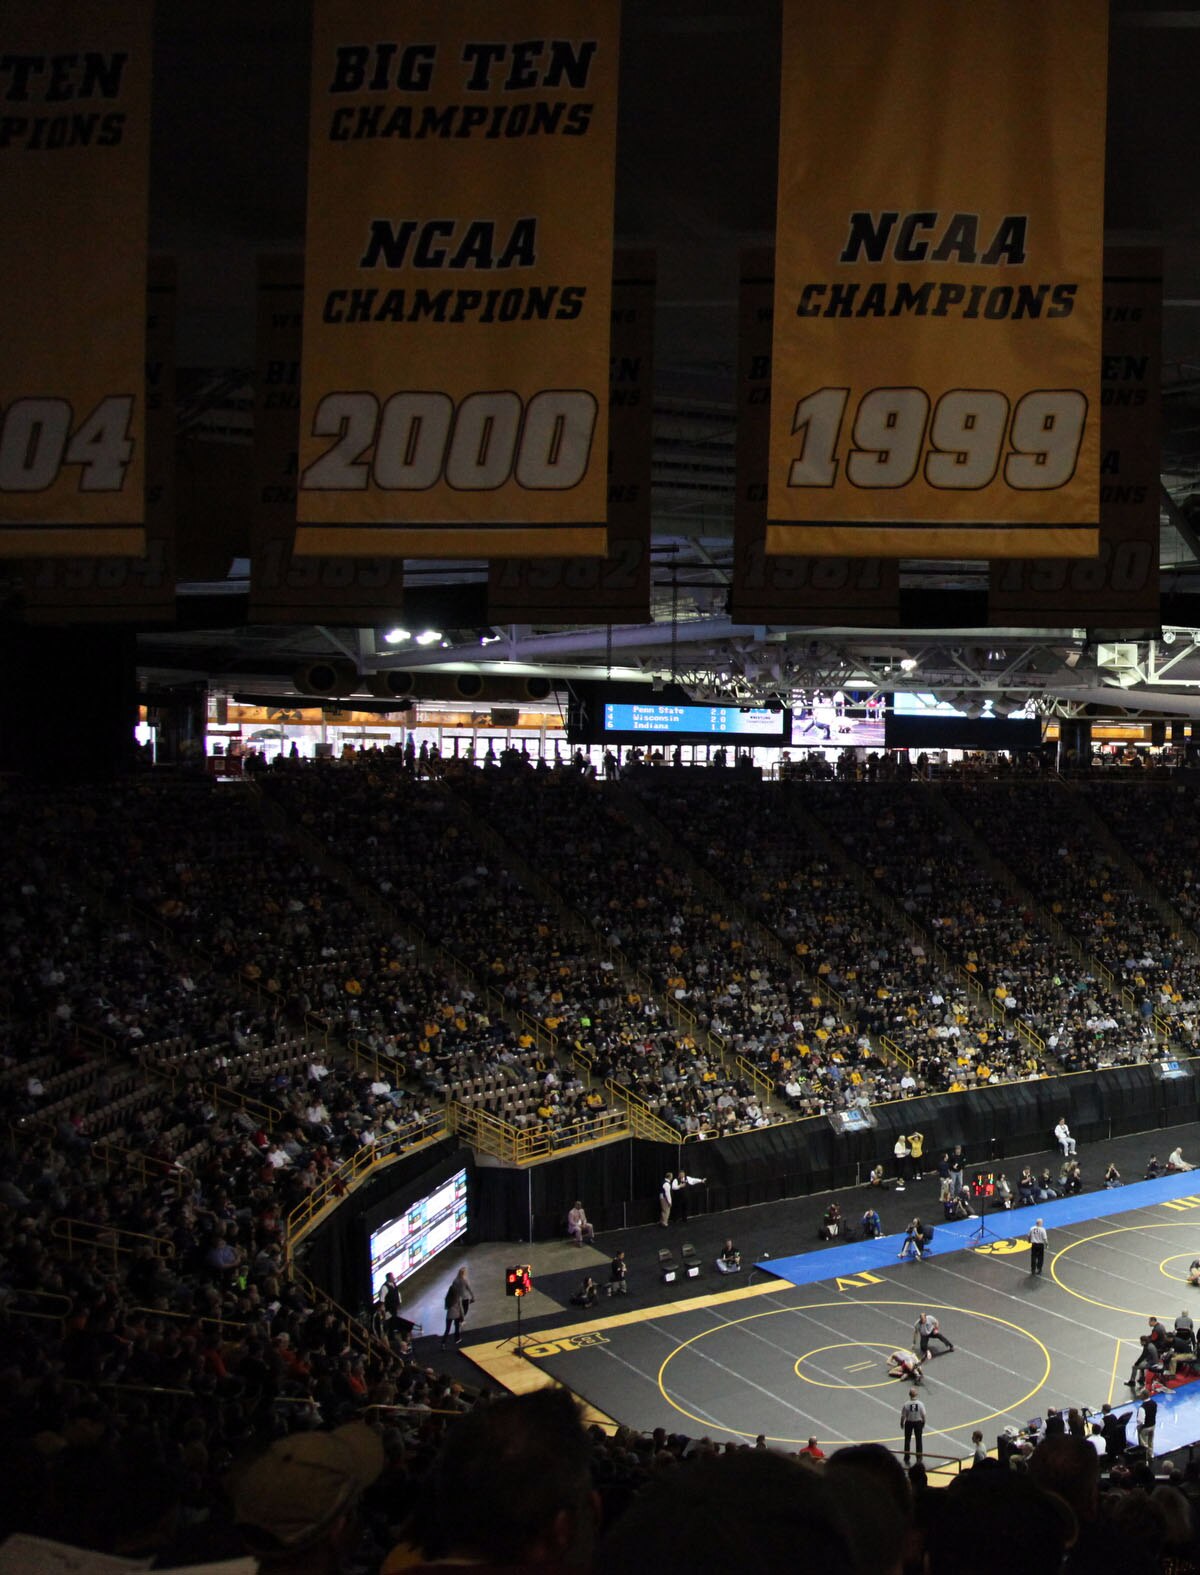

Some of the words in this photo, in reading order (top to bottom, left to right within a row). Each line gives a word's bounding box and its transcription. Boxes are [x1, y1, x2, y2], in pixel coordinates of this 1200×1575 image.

[1, 52, 128, 101] TEN
[328, 43, 437, 93] BIG
[462, 40, 597, 91] TEN
[0, 112, 126, 150] PIONS
[328, 103, 594, 141] CHAMPIONS
[359, 217, 538, 270] NCAA
[839, 211, 1028, 265] NCAA
[322, 286, 587, 324] CHAMPIONS
[796, 282, 1079, 320] CHAMPIONS
[0, 394, 136, 492] 04
[301, 389, 599, 491] 2000
[787, 386, 1089, 490] 1999
[632, 705, 655, 713] Penn
[658, 706, 685, 715] State
[632, 713, 680, 722] Wisconsin
[633, 721, 669, 730] Indiana
